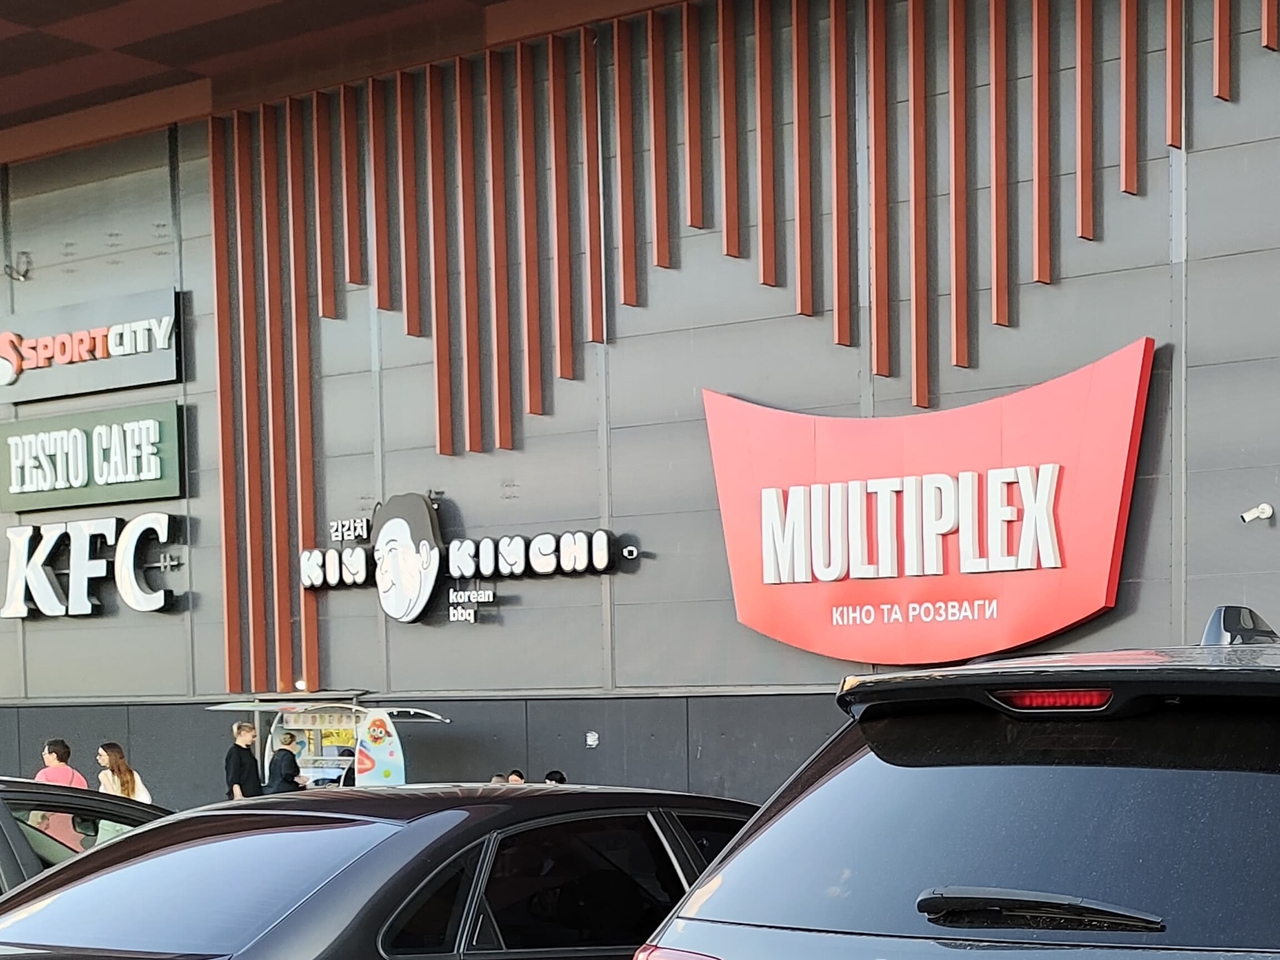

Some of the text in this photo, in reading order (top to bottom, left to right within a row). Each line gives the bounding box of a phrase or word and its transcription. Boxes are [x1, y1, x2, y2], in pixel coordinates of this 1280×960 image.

[7, 419, 161, 494] PESTO CAFE
[329, 518, 368, 541] 김김치
[761, 463, 1063, 584] MULTIPLEX
[0, 513, 169, 619] KFC
[300, 529, 609, 588] KIM KIMCHI
[449, 588, 494, 603] korean
[449, 606, 476, 623] bbq
[831, 599, 998, 626] КІНО ТА РОЗВАГИ
